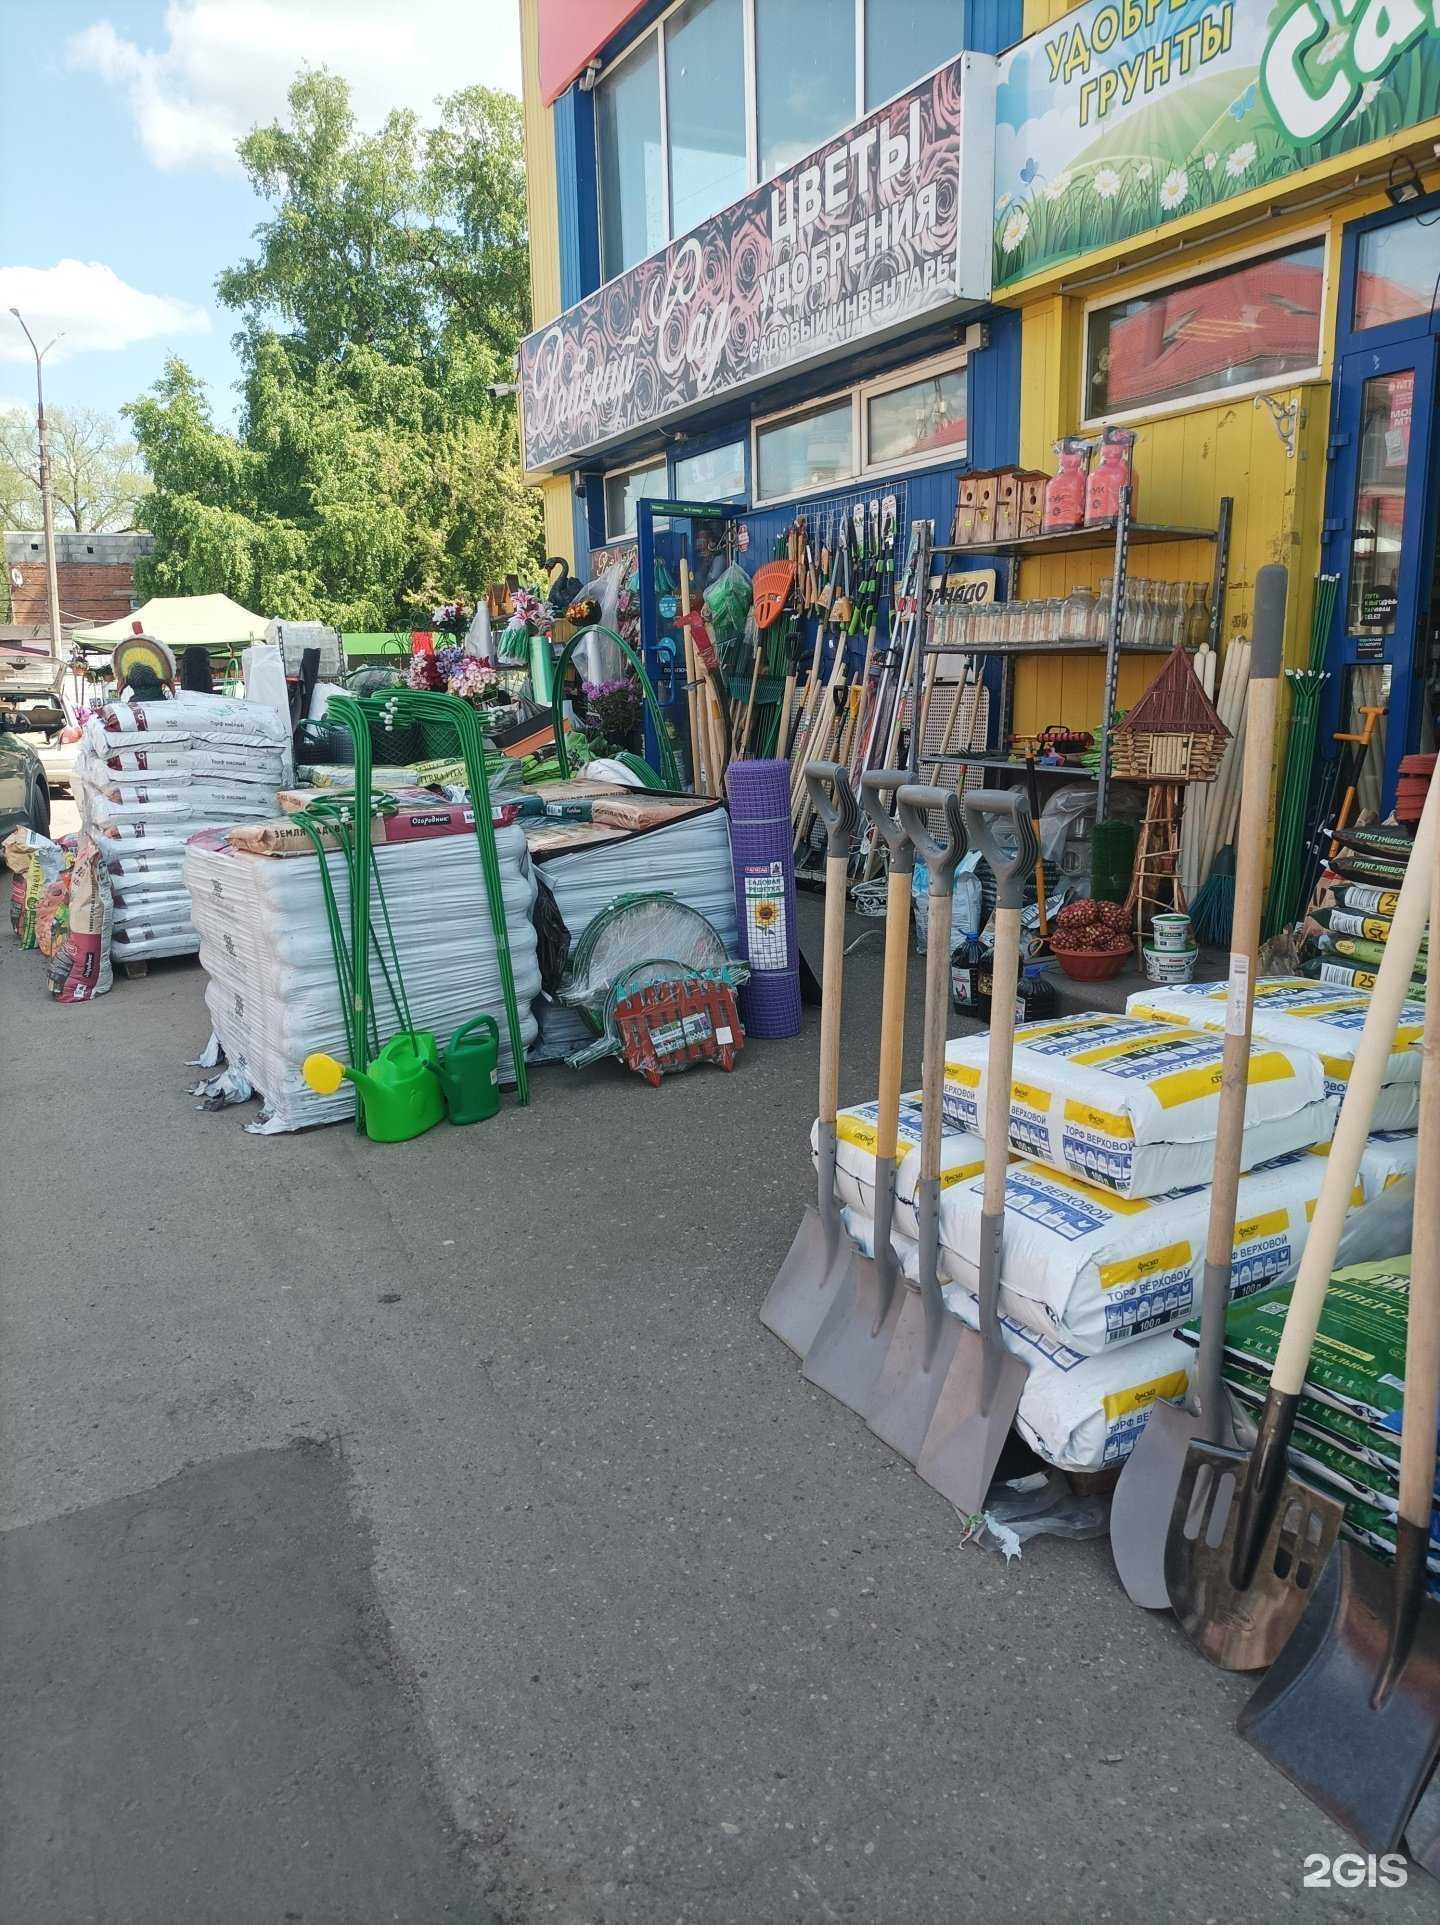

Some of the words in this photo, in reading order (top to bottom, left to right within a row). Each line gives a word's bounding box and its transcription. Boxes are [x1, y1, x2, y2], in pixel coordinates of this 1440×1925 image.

[1045, 0, 1188, 83] УДОБР
[1080, 3, 1233, 127] ГРУНТЫ
[771, 99, 921, 246] ЦВЕТЫ
[759, 182, 937, 309] УДОБРЕНИЯ
[750, 309, 826, 362] САДОВЫЙ
[831, 255, 951, 328] ИНВЕНТАРЬ
[1355, 831, 1378, 841] ГРУНТ
[1353, 861, 1375, 870] ГРУНТ
[1359, 973, 1375, 988] 25
[944, 1084, 976, 1100] ЕРХОВОЙ
[1066, 1126, 1086, 1139] ТОРФ
[1087, 1134, 1135, 1152] ВЕРХОВОЙ
[1009, 1171, 1041, 1191] ТОРФ
[1040, 1185, 1113, 1221] ВЕРХОВОЙ
[1240, 1234, 1288, 1257] ВЕРХОВОЙ
[1107, 1285, 1136, 1302] ТОРФ
[1139, 1268, 1192, 1293] ВЕРХОВОЙ
[1140, 1319, 1154, 1331] 100
[1109, 1418, 1134, 1434] ТОРФ
